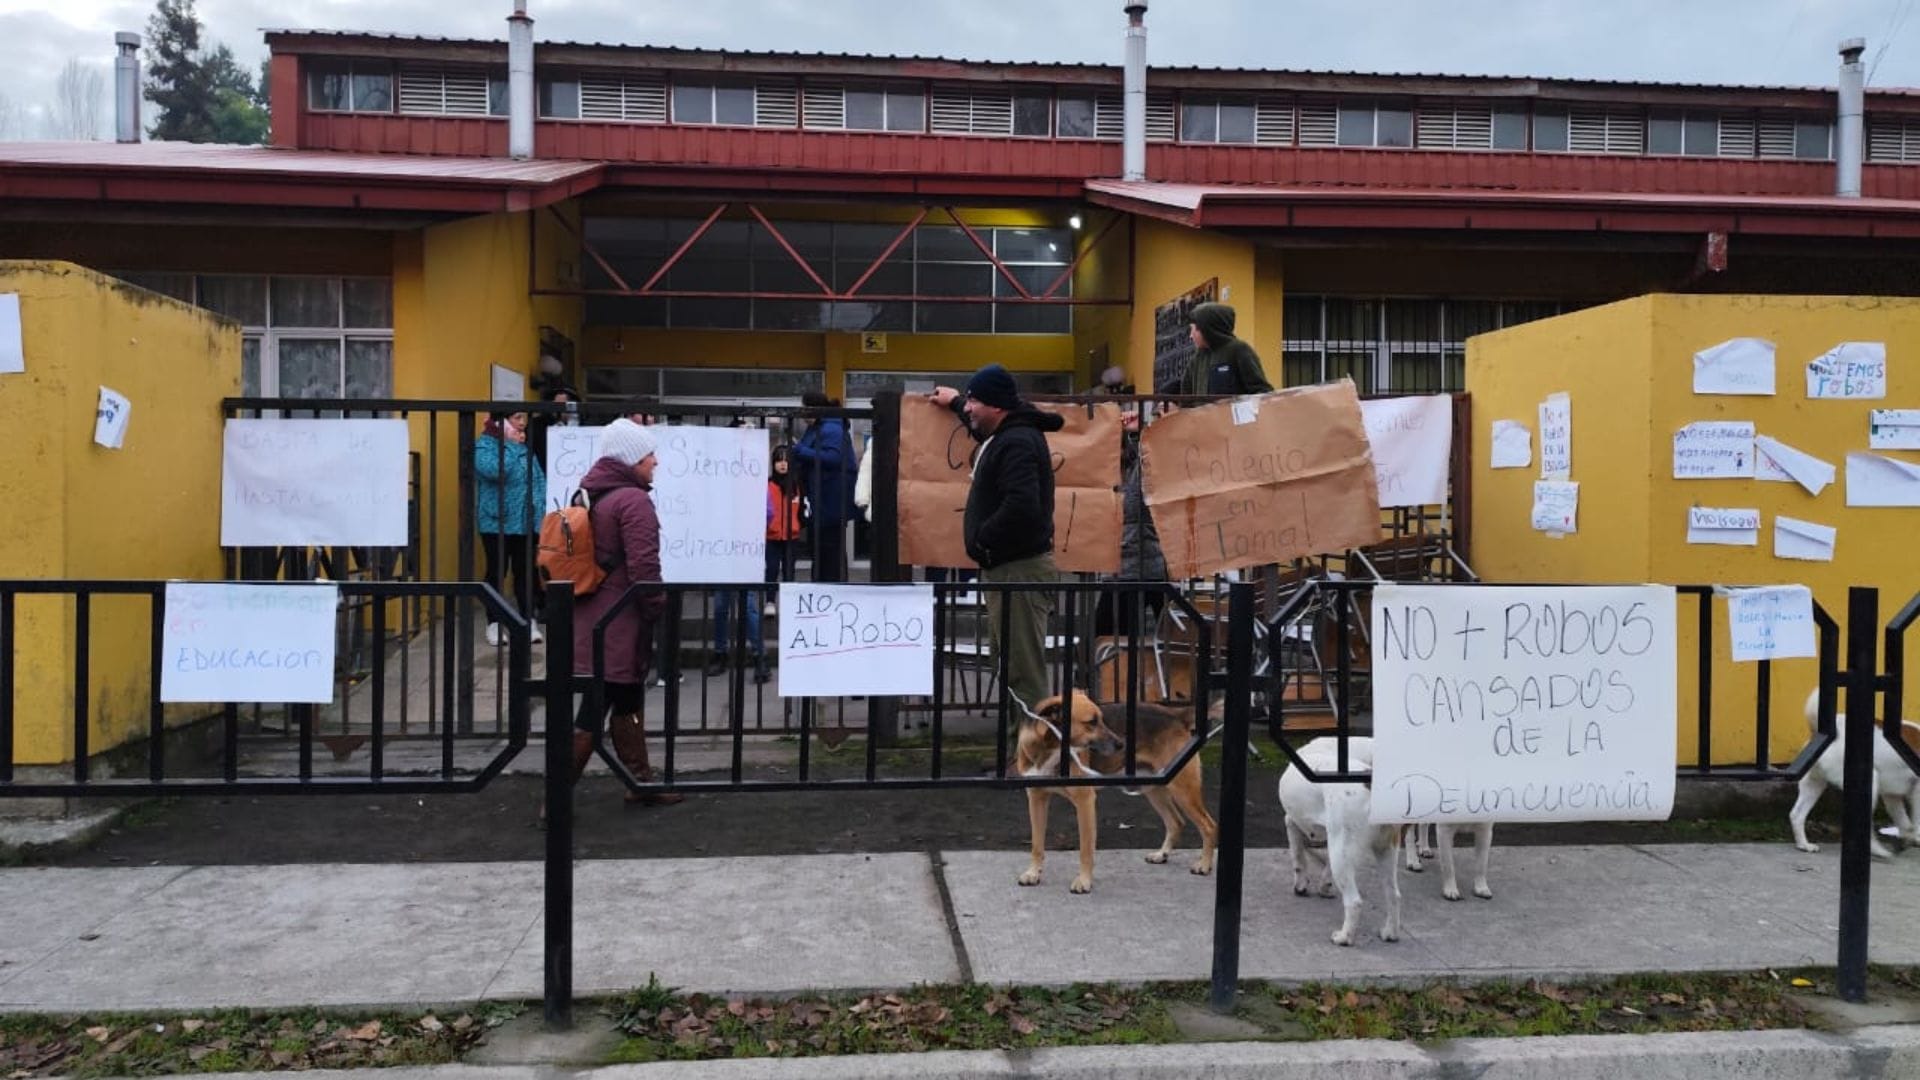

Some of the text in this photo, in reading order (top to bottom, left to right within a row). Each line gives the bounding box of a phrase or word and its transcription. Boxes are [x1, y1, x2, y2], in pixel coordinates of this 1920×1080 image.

[668, 435, 762, 478] Siendo
[1185, 437, 1305, 492] Colegio
[1227, 497, 1256, 516] en
[796, 593, 833, 614] NO
[790, 626, 829, 649] AL
[1383, 606, 1436, 660] NO
[1454, 610, 1486, 660] +
[1567, 718, 1604, 756] LA
